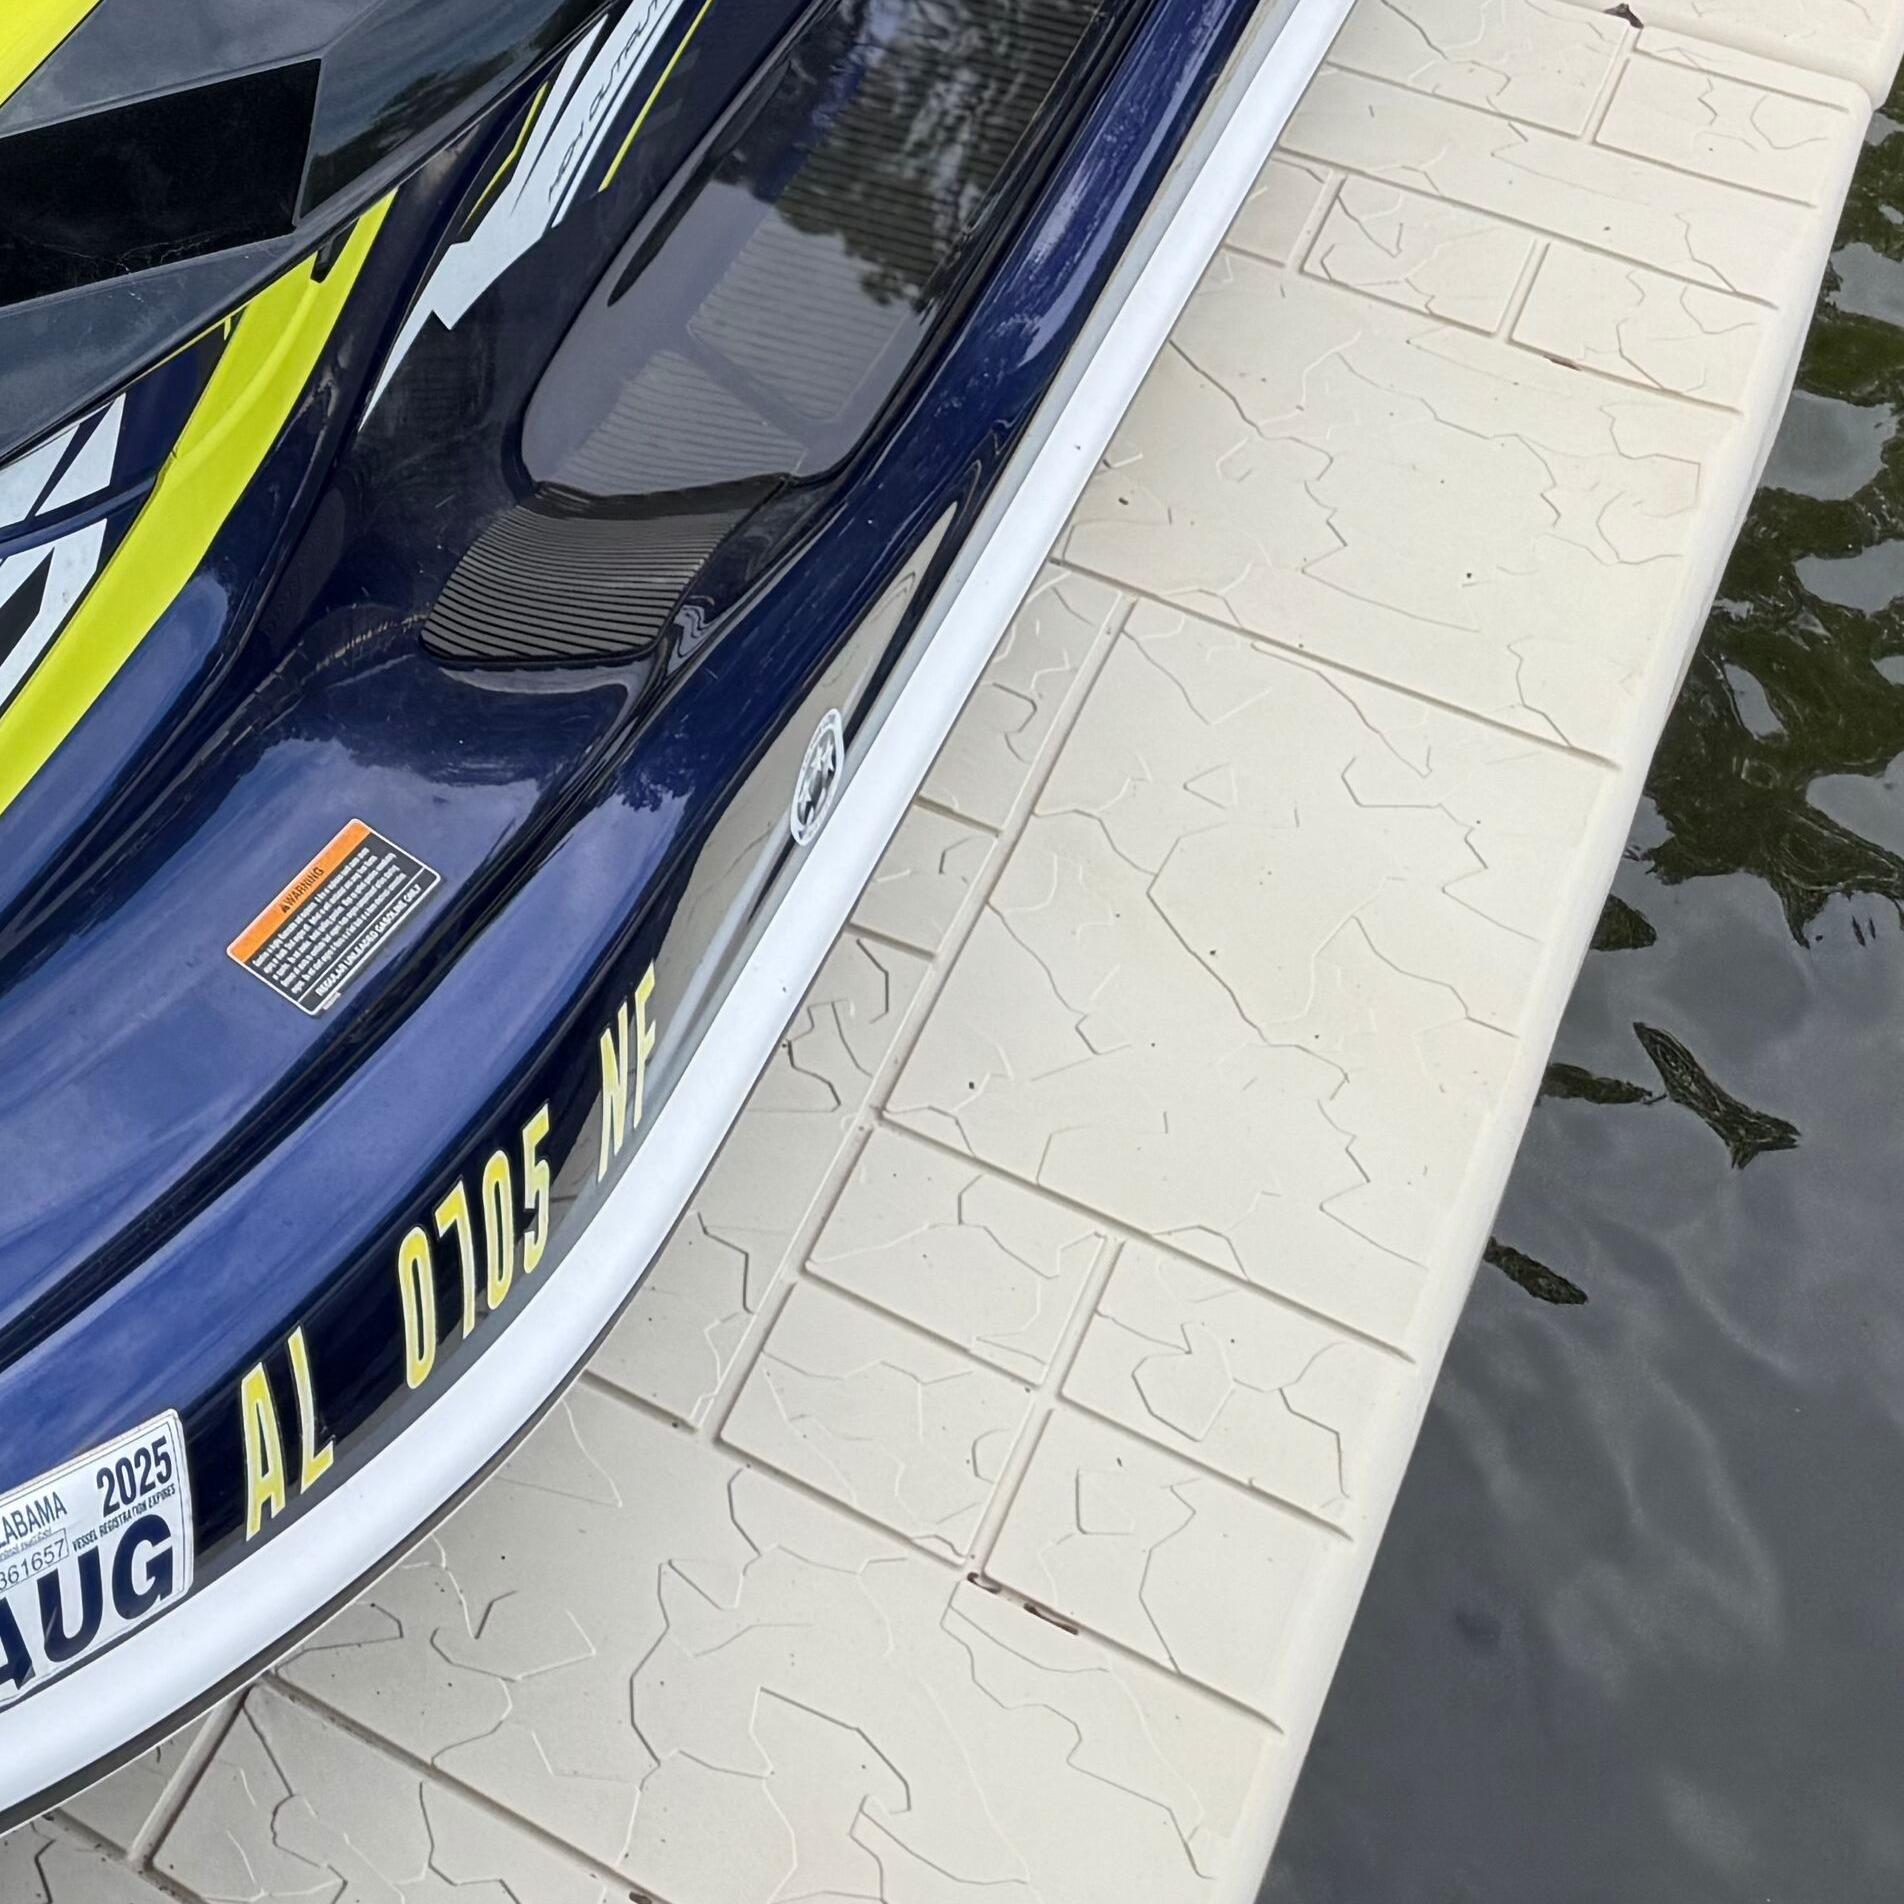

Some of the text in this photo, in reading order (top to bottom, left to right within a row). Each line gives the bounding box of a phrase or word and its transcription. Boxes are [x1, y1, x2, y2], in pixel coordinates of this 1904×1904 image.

[285, 866, 324, 907] WARNING
[242, 961, 655, 1542] AL 0705 NF
[96, 1435, 172, 1518] 2025
[72, 1529, 98, 1552] VESSEL
